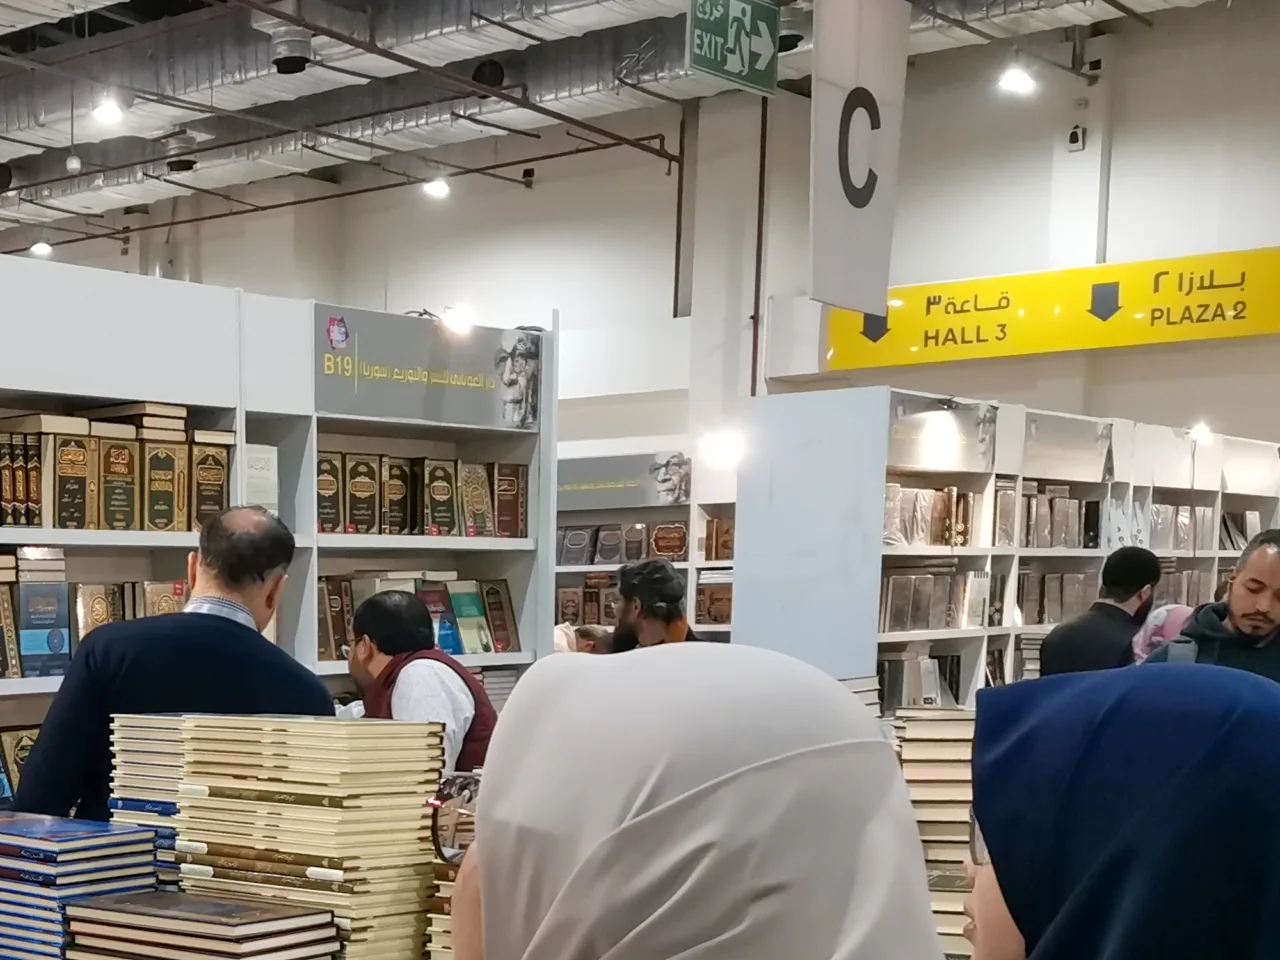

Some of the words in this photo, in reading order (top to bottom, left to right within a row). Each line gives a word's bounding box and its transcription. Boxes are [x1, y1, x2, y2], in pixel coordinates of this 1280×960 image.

[694, 28, 724, 61] EXIT
[838, 86, 881, 209] C
[1152, 271, 1170, 294] ٢
[1178, 268, 1247, 296] بلازا
[925, 294, 942, 317] ٣
[943, 290, 1011, 315] قاعة
[1150, 303, 1225, 327] PLAZA
[1232, 301, 1247, 320] 2
[923, 325, 990, 347] HALL
[994, 323, 1008, 342] 3
[323, 353, 352, 377] B19
